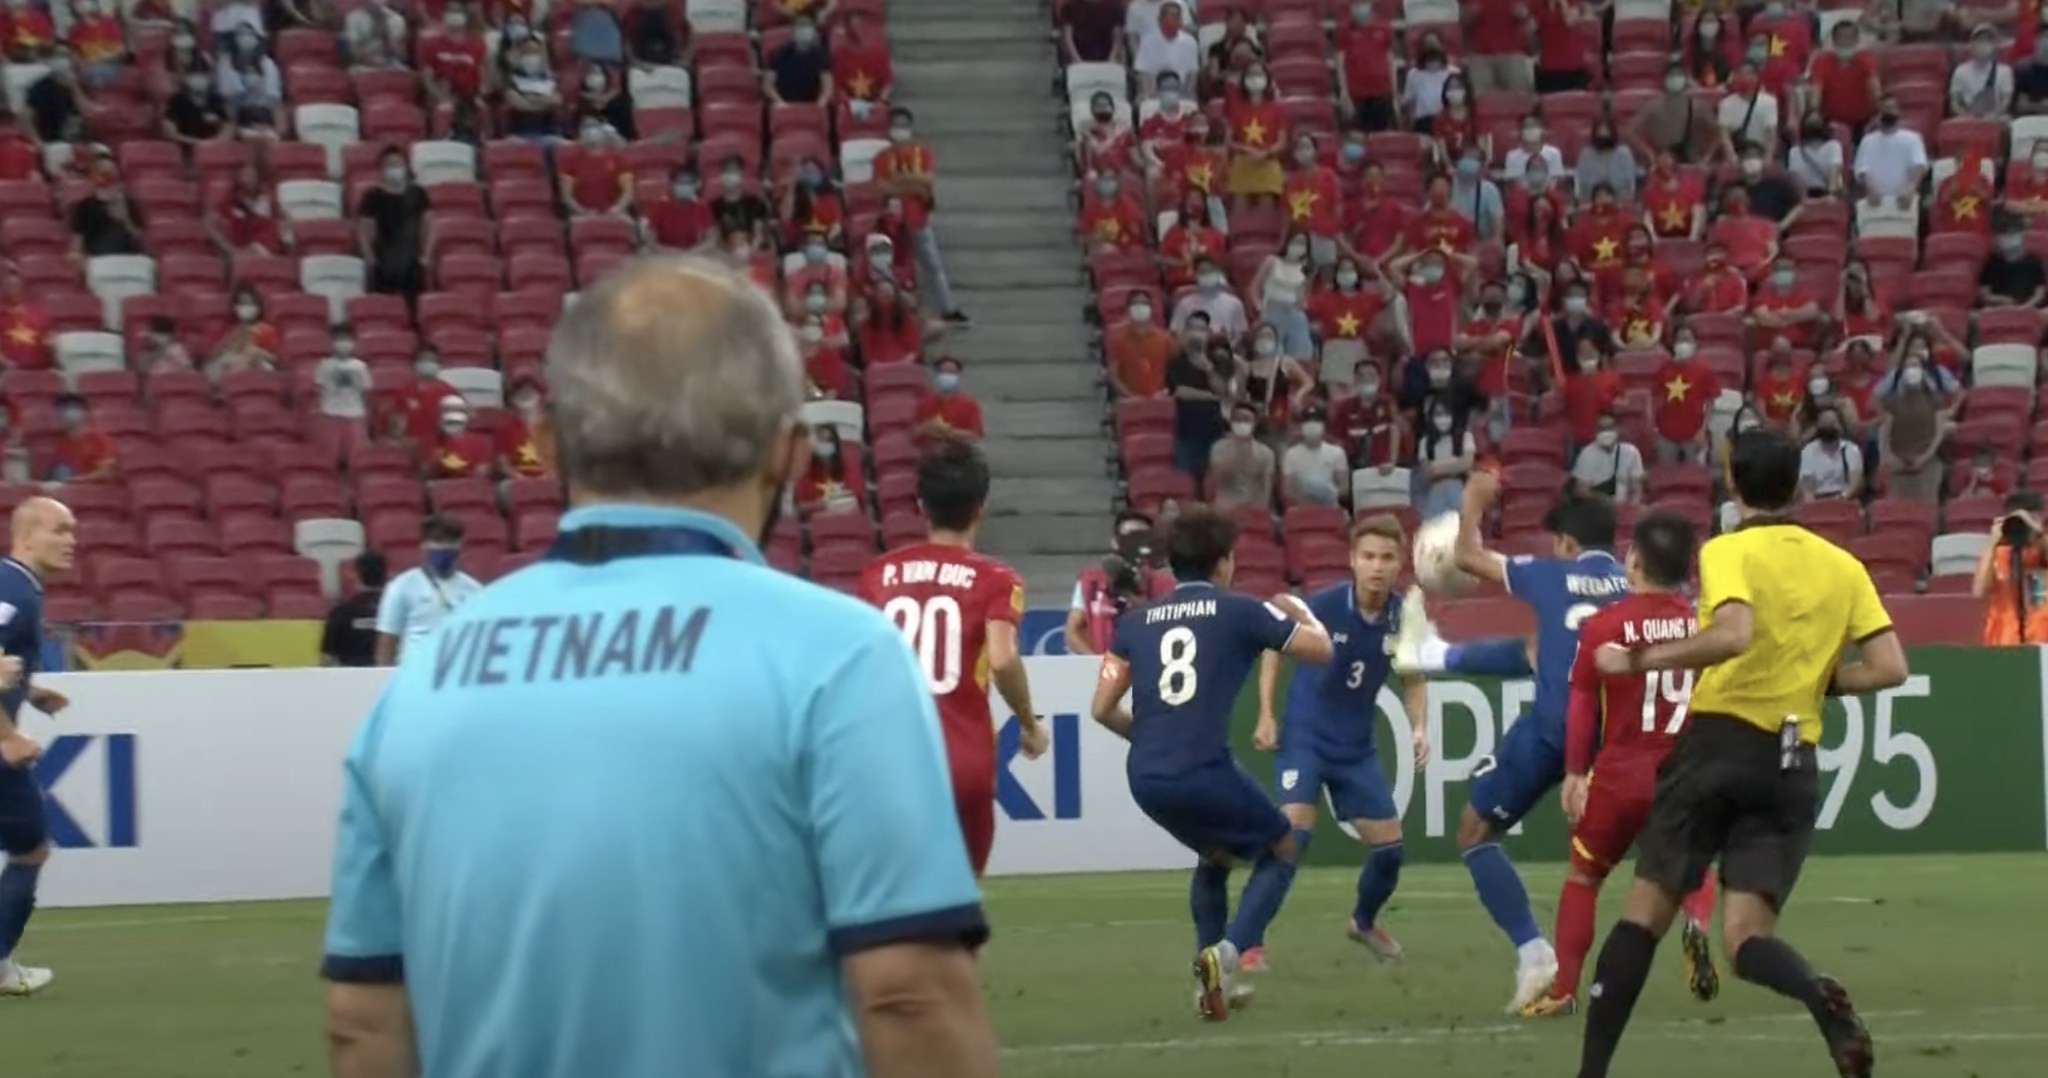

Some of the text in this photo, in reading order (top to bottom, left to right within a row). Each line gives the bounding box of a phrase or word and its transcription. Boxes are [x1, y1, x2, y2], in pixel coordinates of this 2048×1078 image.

[1146, 600, 1217, 625] THITIPHAN
[1624, 620, 1640, 643] N.
[1642, 618, 1685, 643] QUANG
[432, 605, 713, 691] VIETNAM
[1158, 627, 1198, 705] 8
[1346, 660, 1365, 689] 3
[1642, 669, 1694, 734] 19
